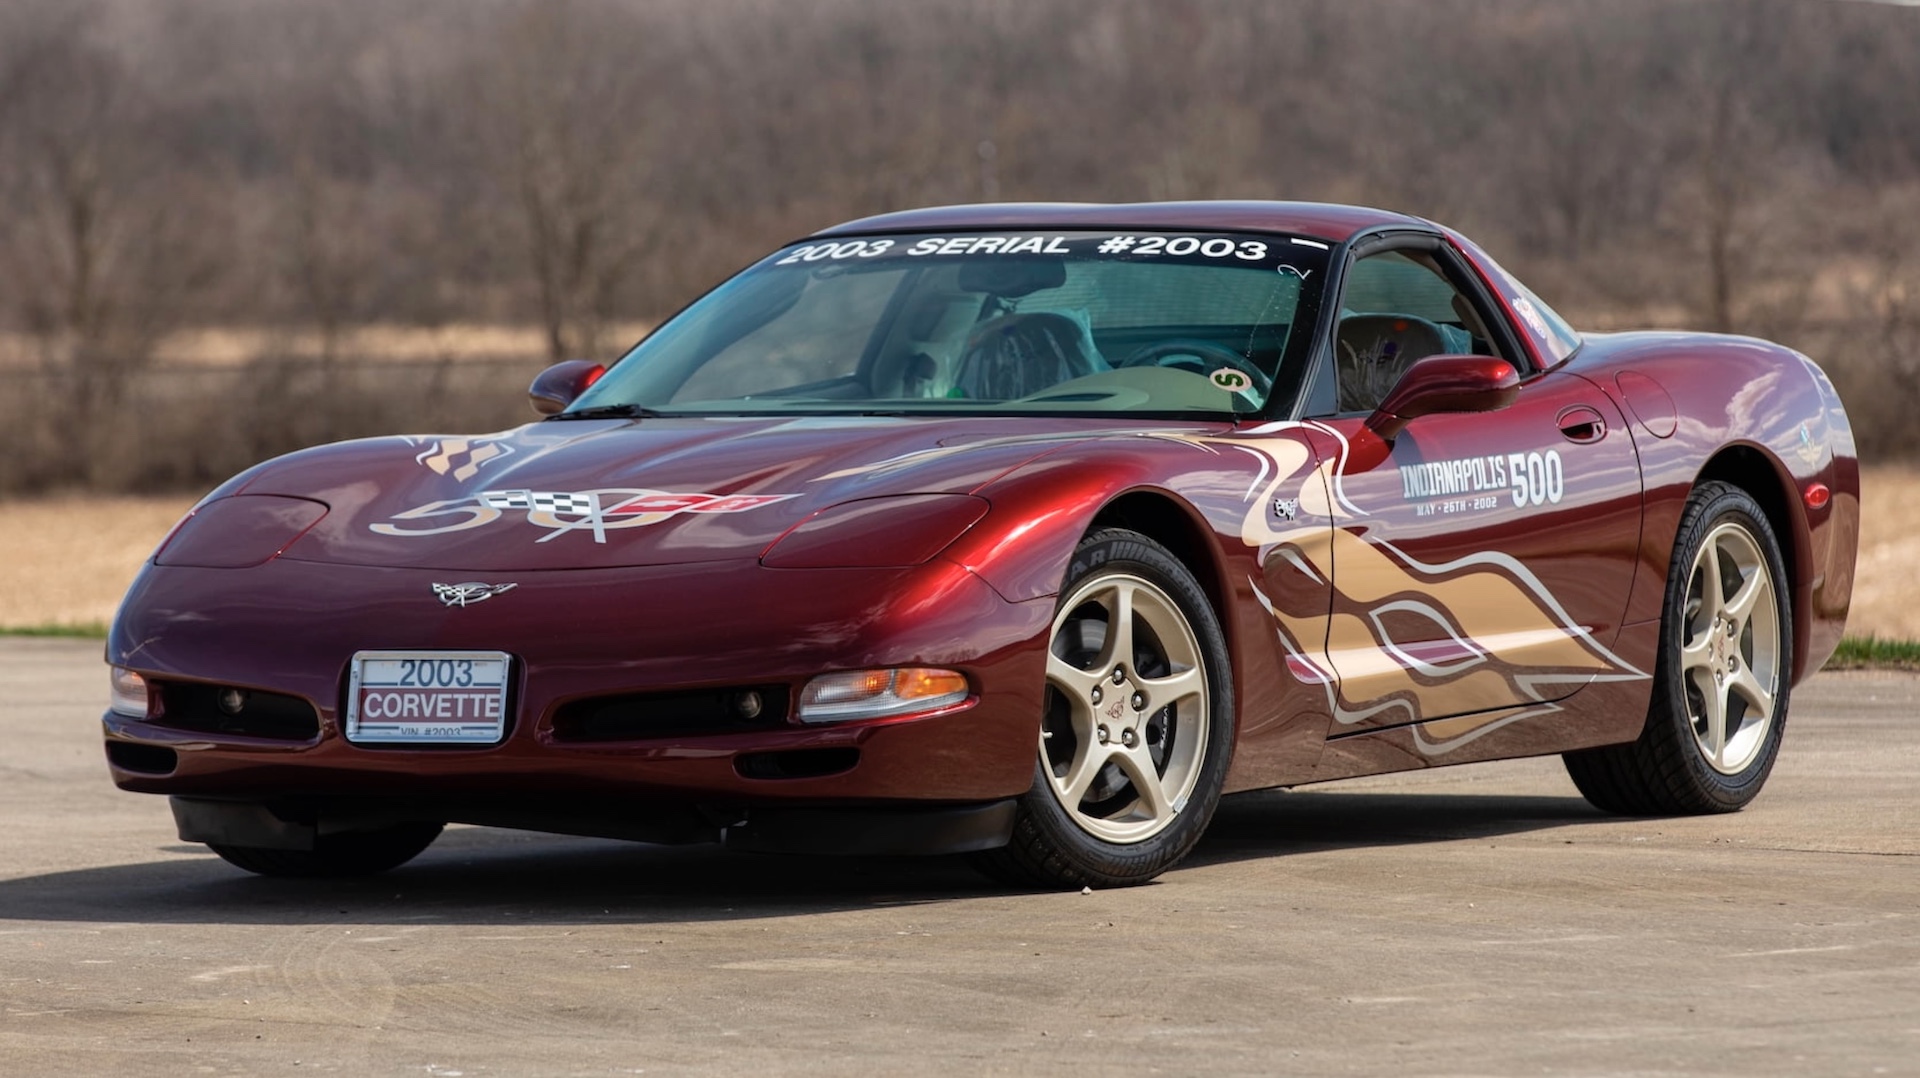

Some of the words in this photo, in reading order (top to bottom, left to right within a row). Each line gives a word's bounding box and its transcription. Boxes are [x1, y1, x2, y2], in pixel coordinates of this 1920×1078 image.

[775, 239, 895, 265] 2003
[907, 236, 1070, 256] SERIAL
[1097, 236, 1268, 260] #2003
[1400, 454, 1507, 498] INDIANAPOLIS
[1508, 450, 1563, 508] 500
[1416, 503, 1436, 516] MAY
[1443, 499, 1467, 513] 26TH
[1473, 496, 1498, 510] 2002
[399, 660, 473, 687] 2003
[364, 692, 500, 718] CORVETTE
